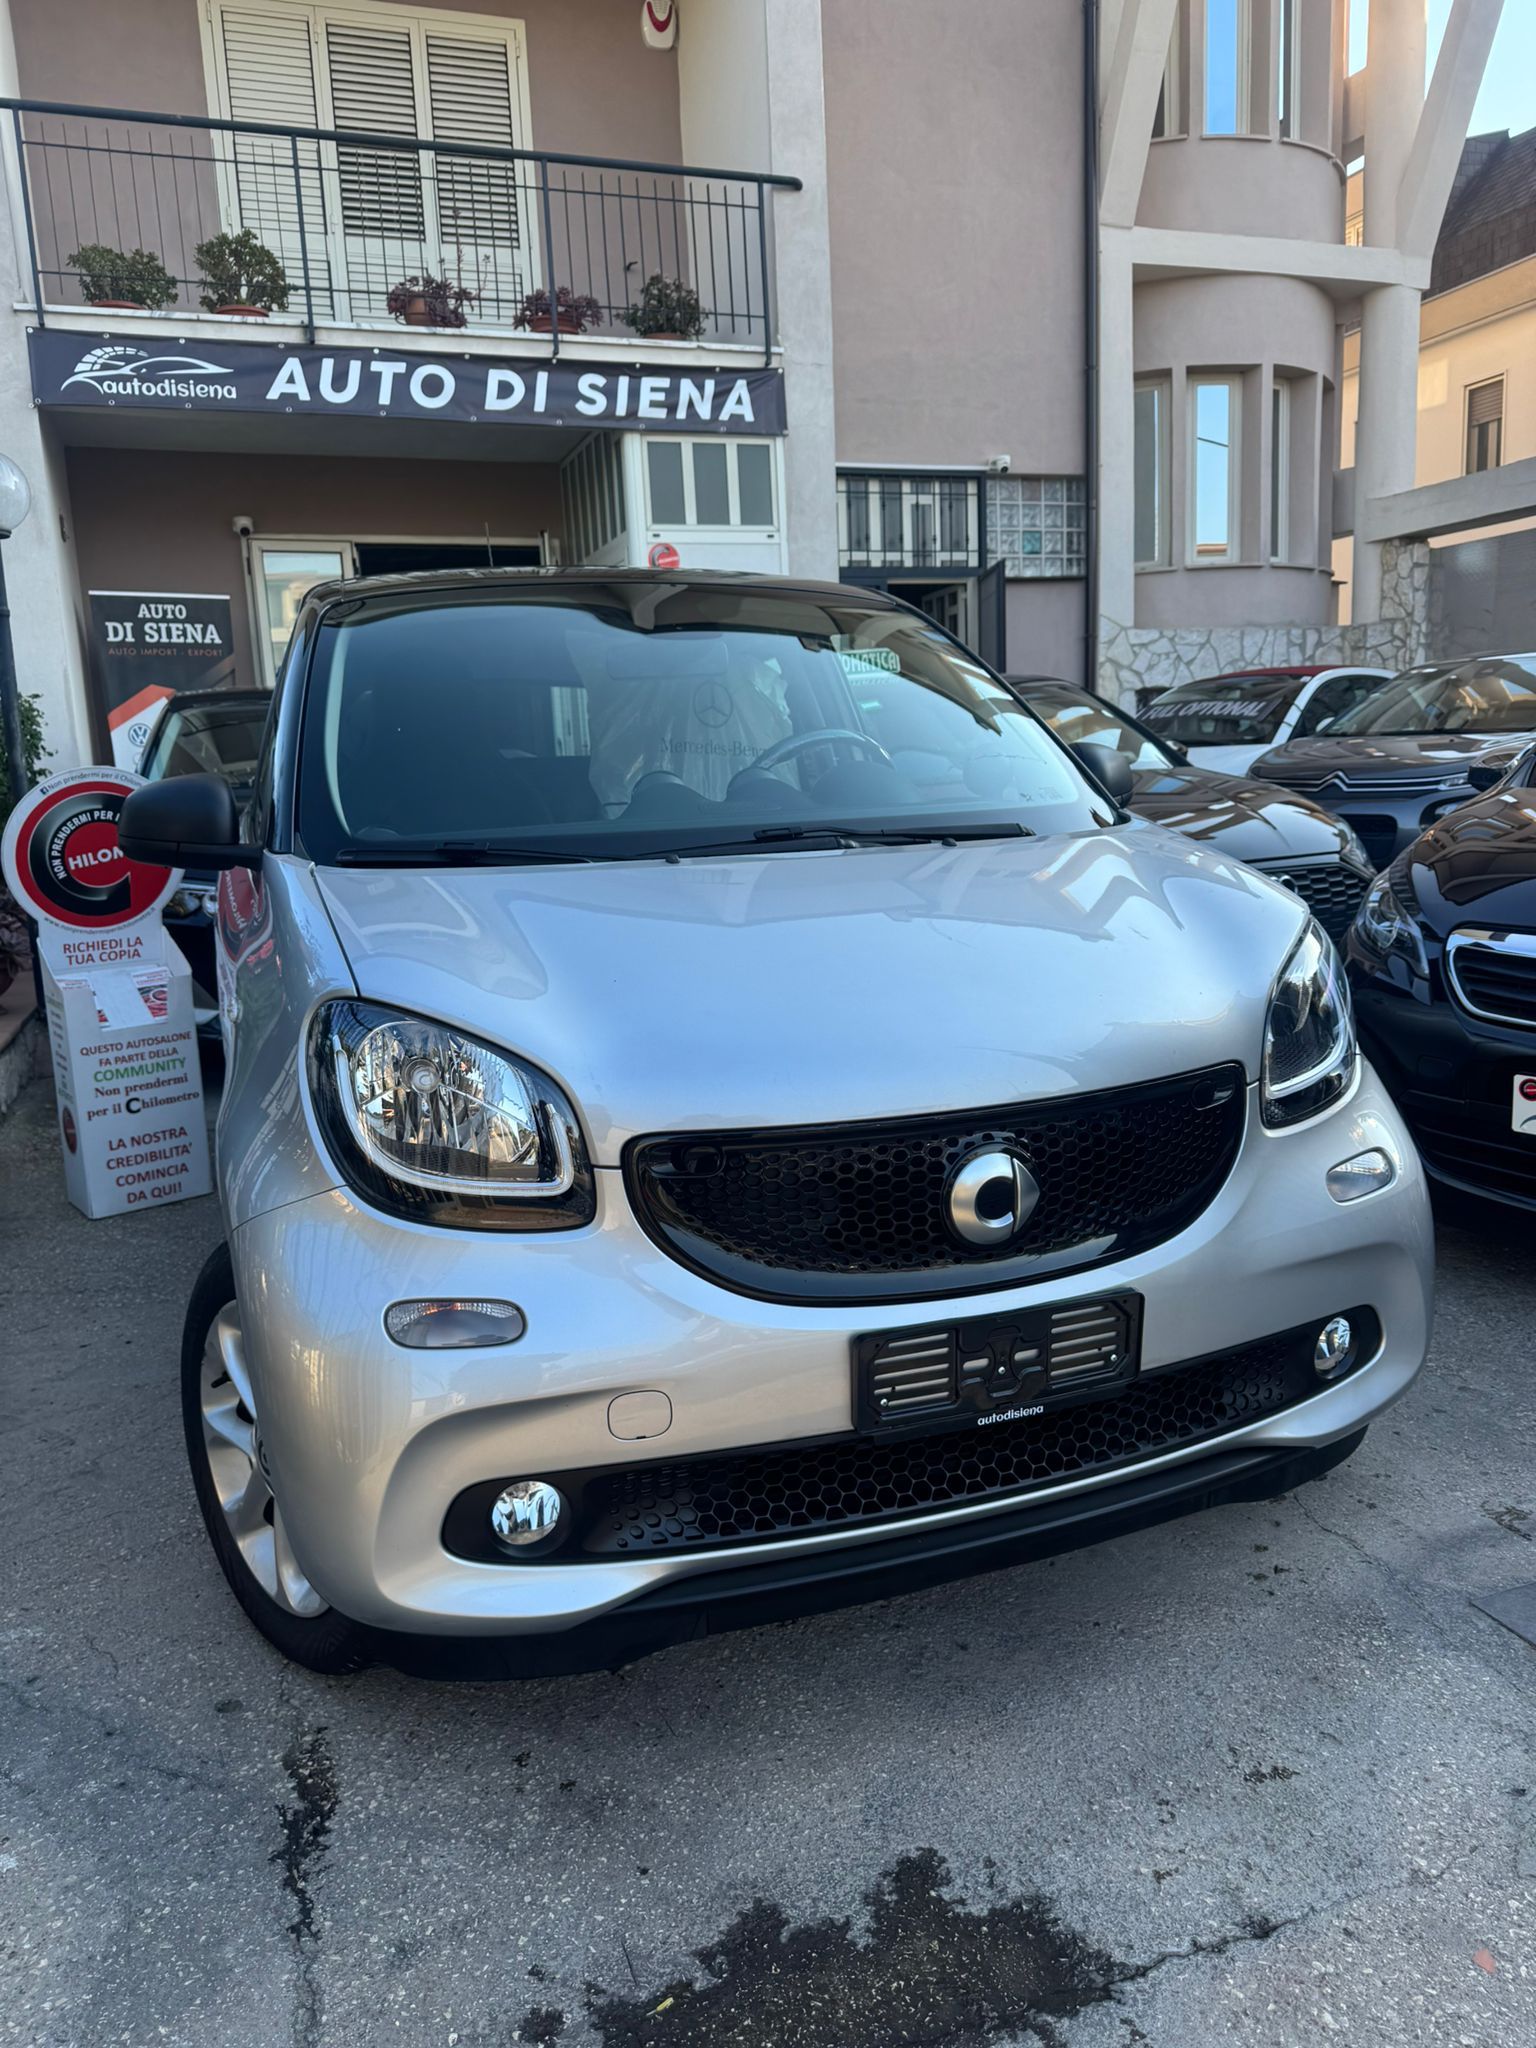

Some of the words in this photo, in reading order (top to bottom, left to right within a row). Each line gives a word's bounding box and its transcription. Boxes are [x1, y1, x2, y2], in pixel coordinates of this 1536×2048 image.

[102, 377, 238, 400] autodisiena
[265, 356, 456, 410] AUTO
[484, 368, 549, 413] DI
[574, 372, 755, 423] SIENA
[137, 603, 187, 619] AUTO
[105, 622, 135, 642] DI
[144, 622, 222, 644] SIENA
[108, 647, 137, 656] AUTO
[140, 648, 177, 656] IMPORT
[187, 649, 222, 657] EXPORT
[1141, 703, 1184, 720] FULL
[1178, 701, 1267, 717] OPTIONAL
[93, 810, 114, 820] PER
[51, 812, 91, 857] PRENDERMI
[51, 859, 68, 880] NON
[63, 939, 123, 955] RICHIEDI
[127, 936, 144, 948] LA
[66, 953, 96, 966] TUA
[99, 948, 142, 963] COPIA
[80, 1042, 124, 1057] QUESTO
[126, 1031, 193, 1050] AUTOSALONE
[98, 1058, 113, 1068] FA
[114, 1052, 146, 1065] PARTE
[148, 1047, 179, 1060] DELLA
[93, 1057, 187, 1083] COMMUNITY
[94, 1087, 121, 1099] Non
[124, 1073, 189, 1097] prendermi
[87, 1107, 110, 1122] per
[112, 1103, 122, 1115] il
[125, 1090, 200, 1115] Chilometro
[108, 1138, 127, 1151] LA
[130, 1126, 188, 1147] NOSTRA
[115, 1163, 189, 1188] COMINCIA
[127, 1190, 148, 1204] DA
[150, 1182, 182, 1199] QUI!
[977, 1405, 1044, 1426] autodisiena
